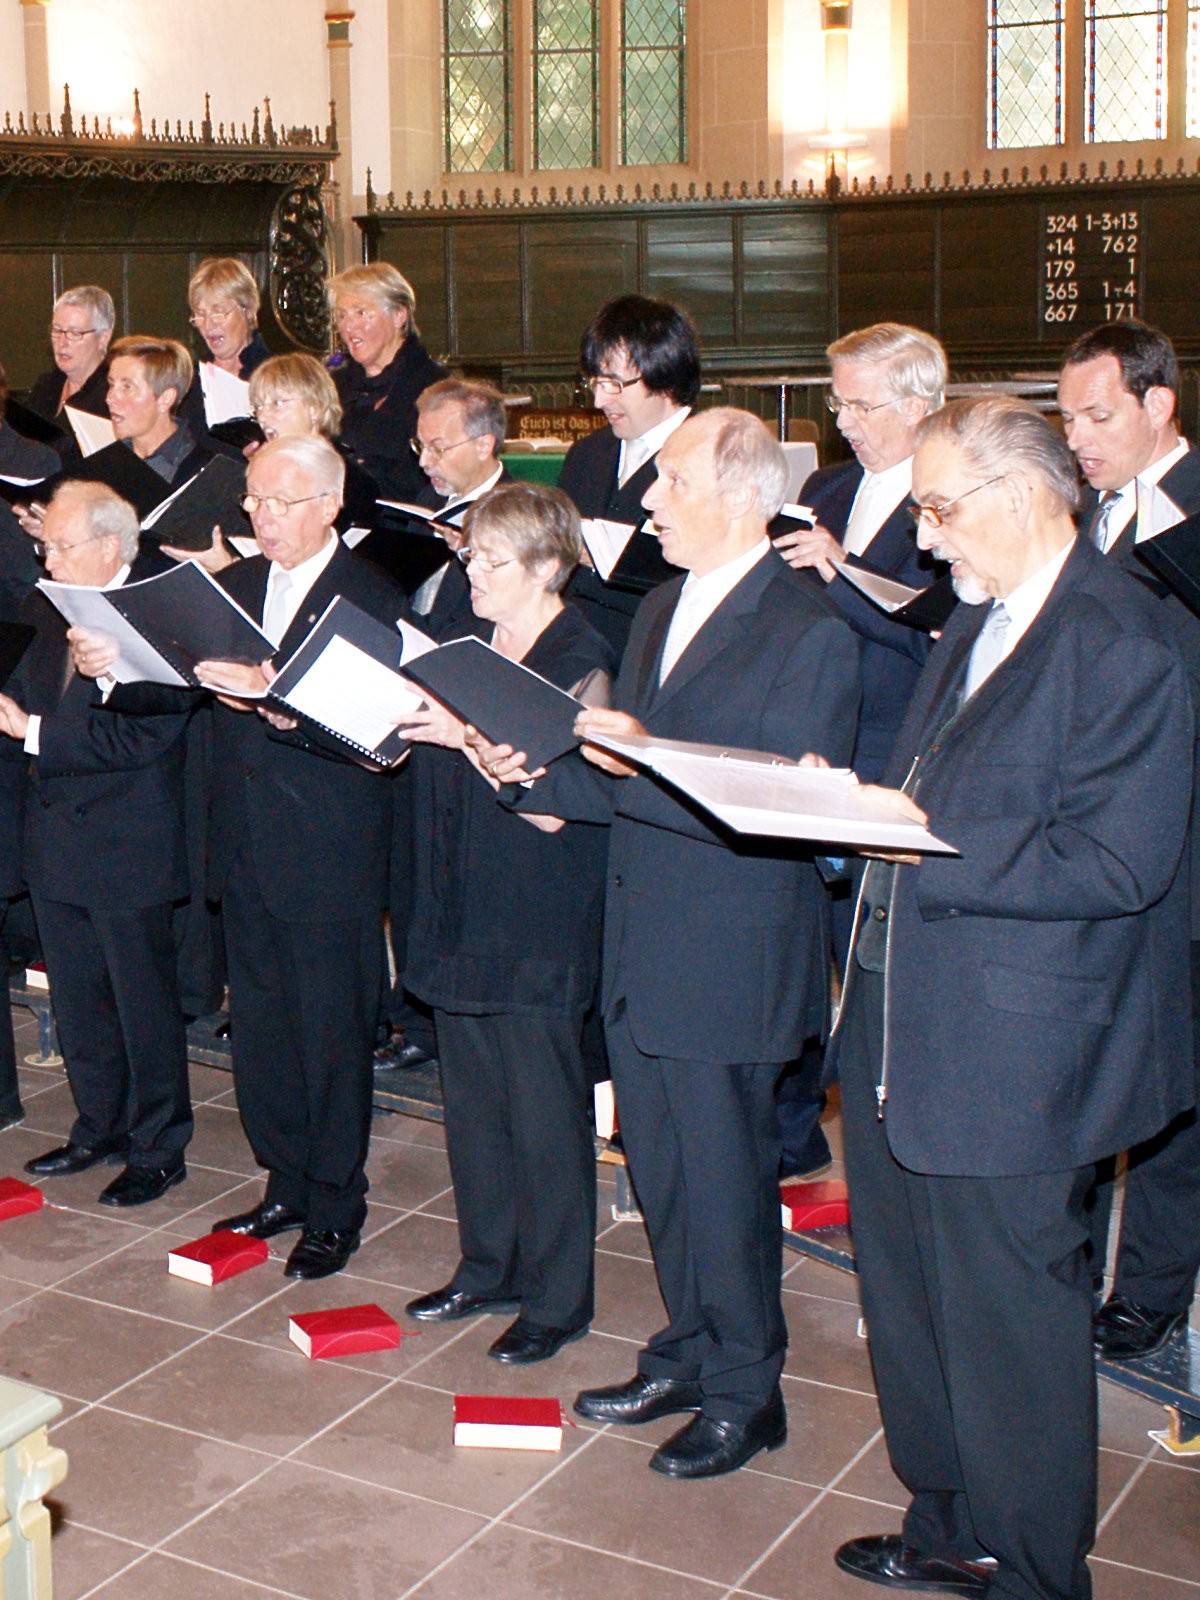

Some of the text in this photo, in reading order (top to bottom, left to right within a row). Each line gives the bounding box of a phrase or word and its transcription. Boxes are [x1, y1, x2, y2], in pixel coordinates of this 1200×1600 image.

[1046, 212, 1138, 234] 324 1-3+13
[1046, 235, 1138, 255] +14 762
[1045, 257, 1135, 278] 179 1
[1045, 282, 1078, 301] 365
[1045, 303, 1135, 323] 667 171
[553, 416, 567, 429] ist
[569, 416, 590, 429] das
